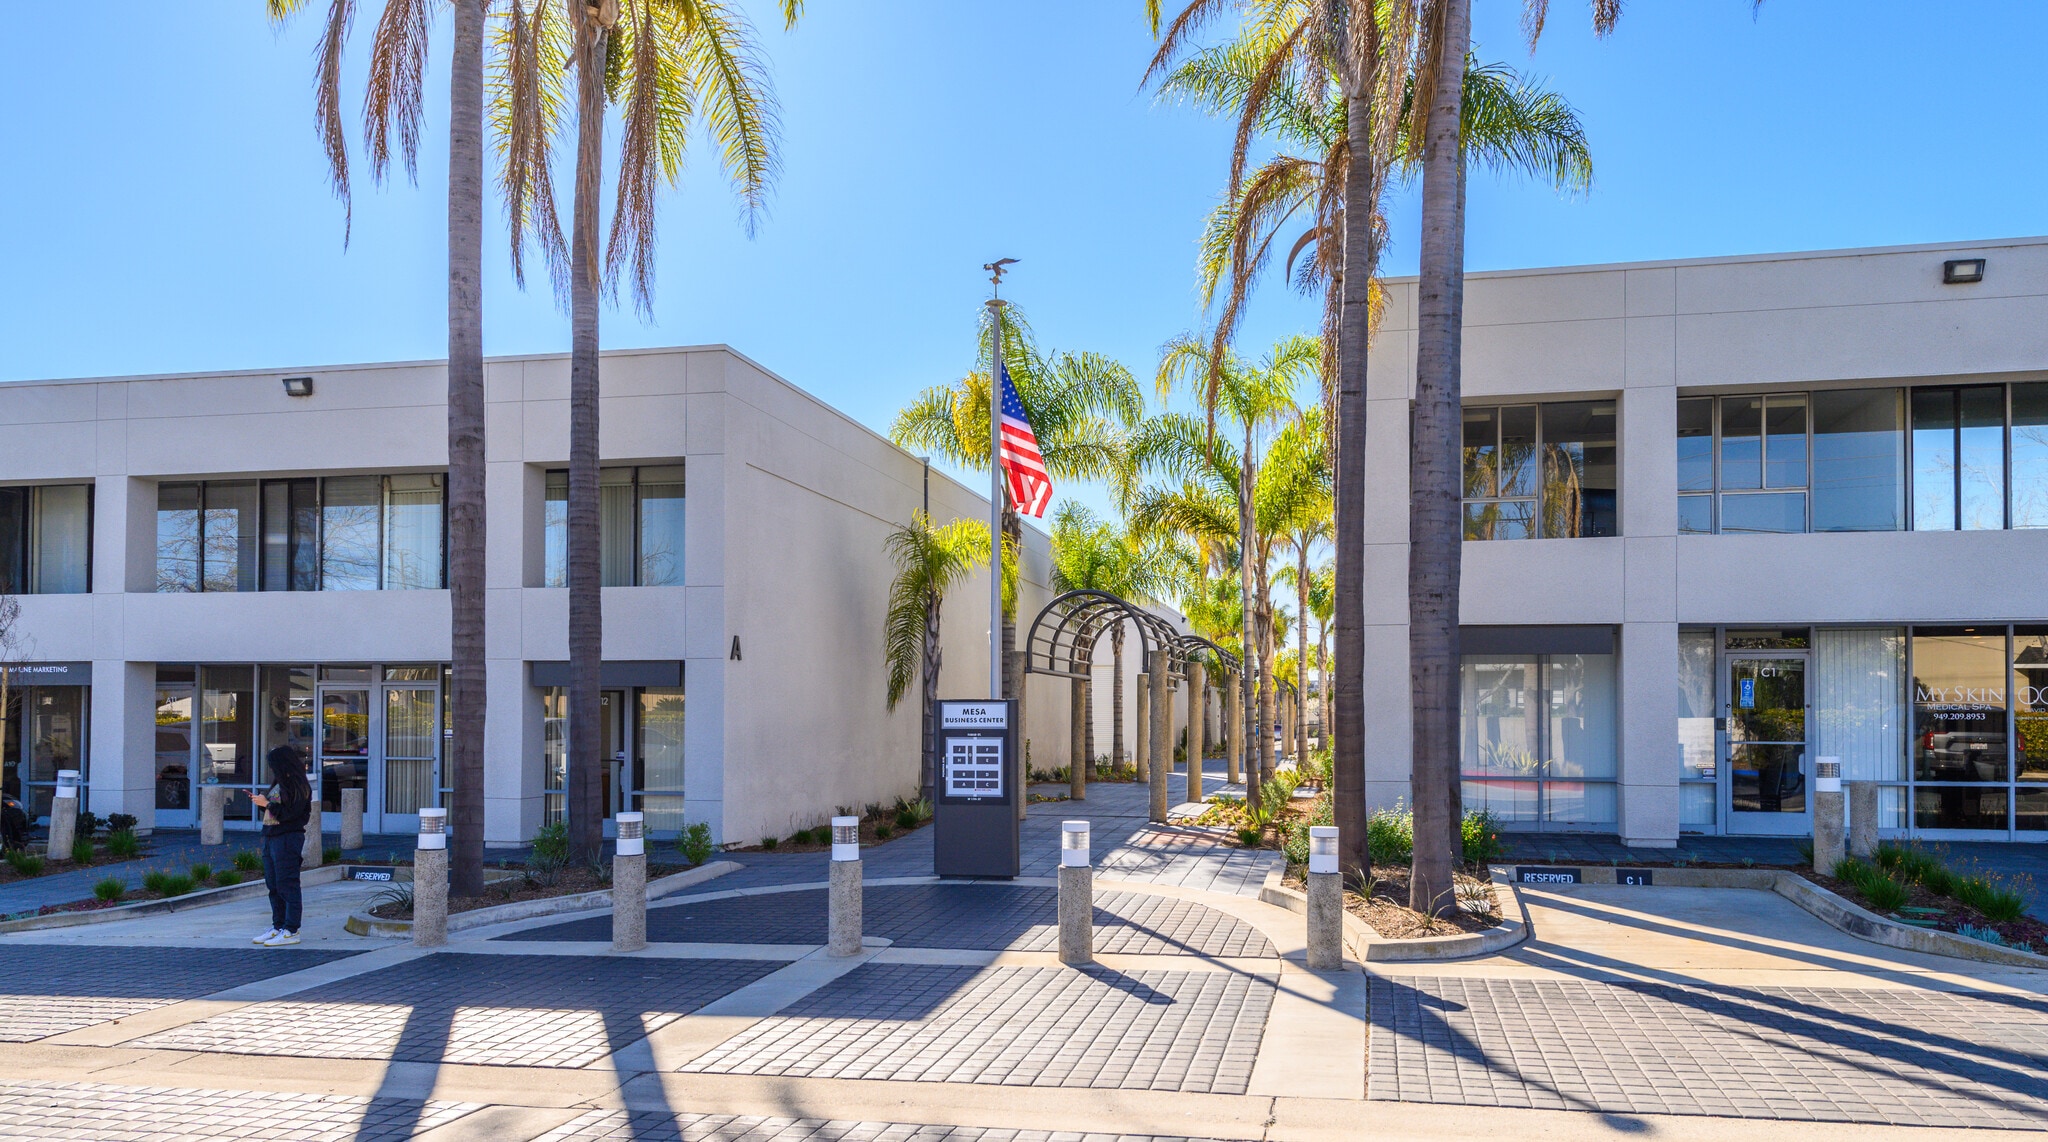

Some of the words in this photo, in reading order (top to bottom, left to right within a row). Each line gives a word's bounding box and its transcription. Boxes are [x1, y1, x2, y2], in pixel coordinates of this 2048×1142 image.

[730, 635, 742, 660] A
[1761, 667, 1776, 677] C1
[1953, 686, 2004, 702] SKIN
[1971, 703, 1992, 711] SPA
[1933, 712, 1986, 721] 949.209.8953
[355, 872, 390, 880] RESERVED
[1523, 872, 1574, 884] RESERVED
[1626, 876, 1634, 885] C
